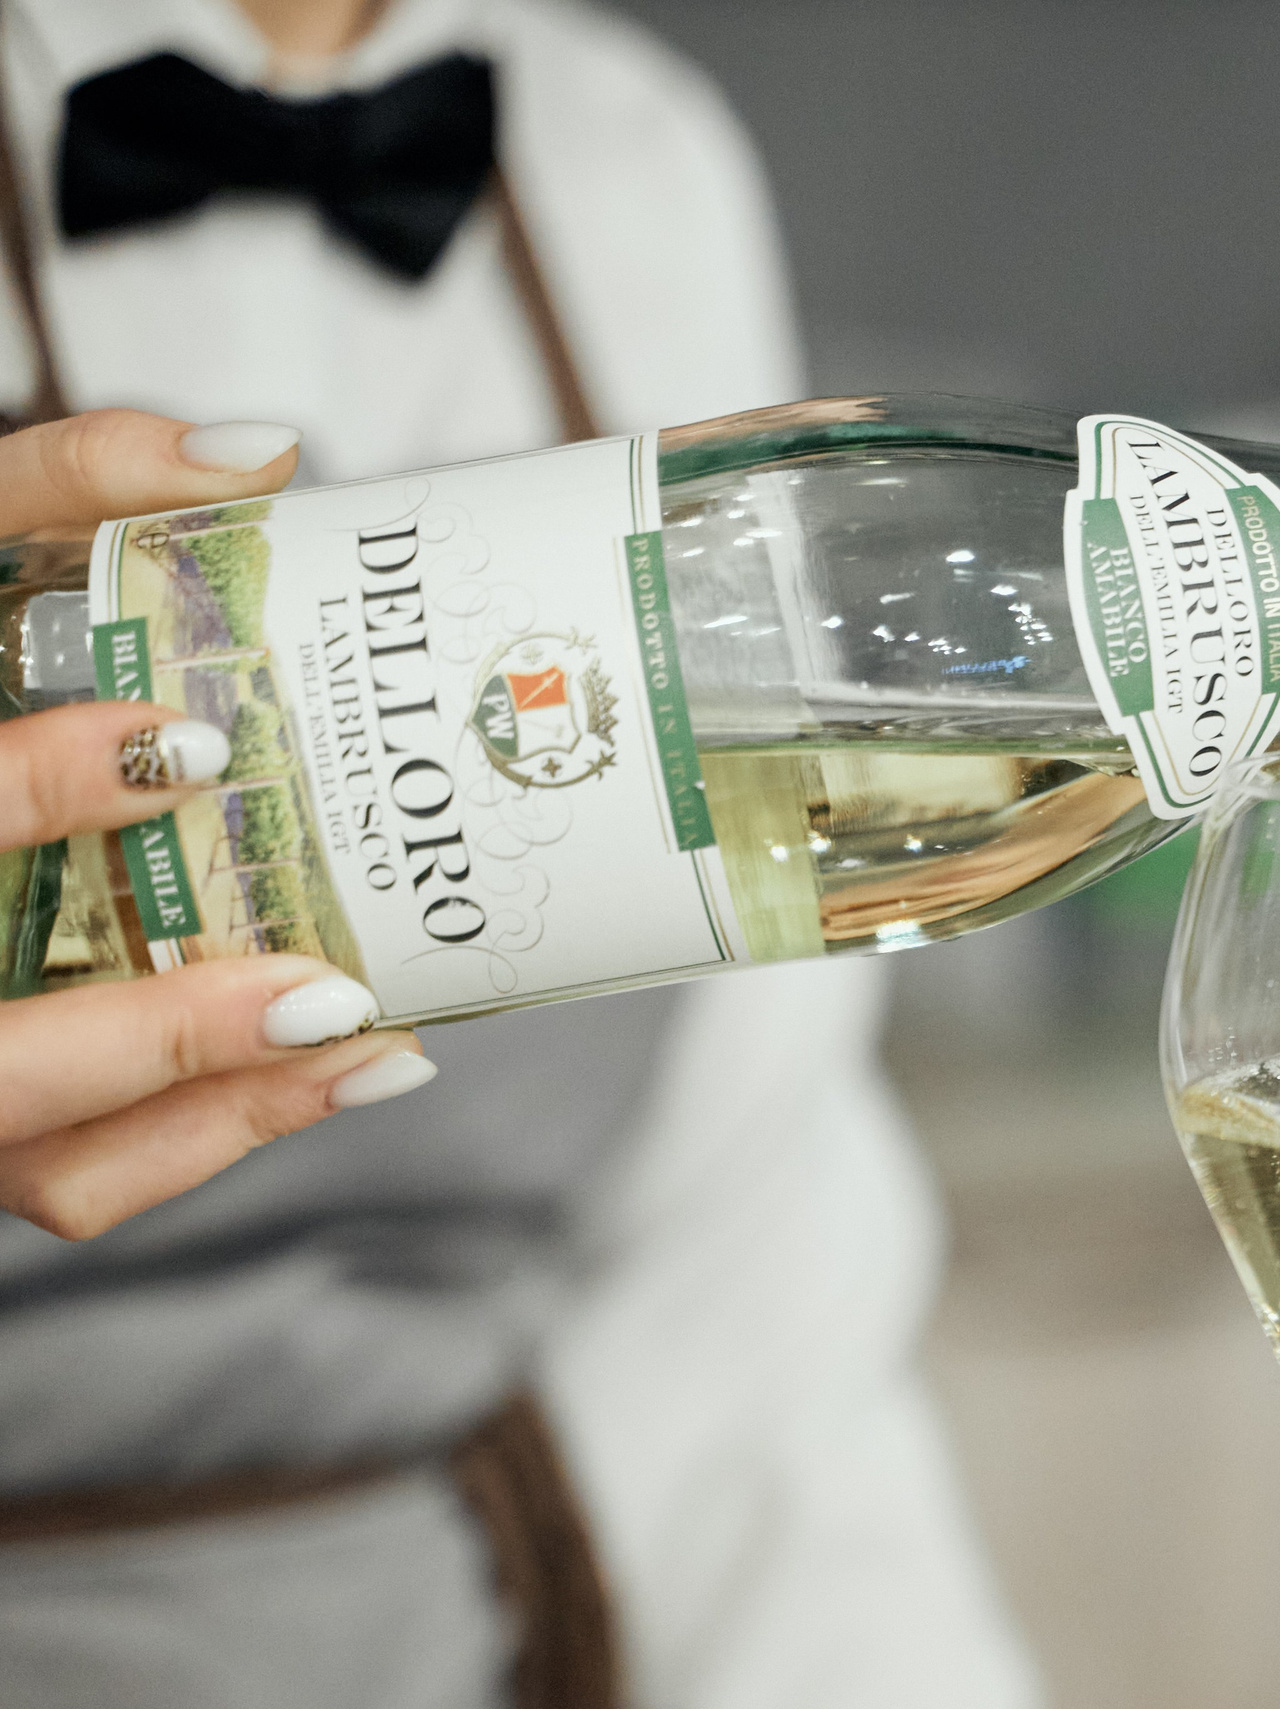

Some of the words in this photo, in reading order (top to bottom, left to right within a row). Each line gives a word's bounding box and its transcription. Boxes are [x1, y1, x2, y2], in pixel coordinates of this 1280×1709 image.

[1088, 542, 1129, 678] AMABILE
[1110, 546, 1148, 663] BIANCO
[1127, 440, 1227, 777] LAMBRUSCO
[1129, 495, 1178, 659] DELL'EMILIA
[1165, 667, 1183, 714] IGT
[1206, 507, 1254, 677] DELLORO
[1236, 495, 1280, 592] PRODOTTO
[300, 644, 337, 802] DELL'EMILIA
[328, 811, 350, 854] IGT
[319, 596, 397, 891] LAMBRUSCO
[358, 522, 486, 943] DELLORO
[482, 694, 514, 739] PW
[631, 538, 669, 690] PRODOTTO
[657, 704, 677, 734] IN
[667, 750, 699, 850] ITALIA
